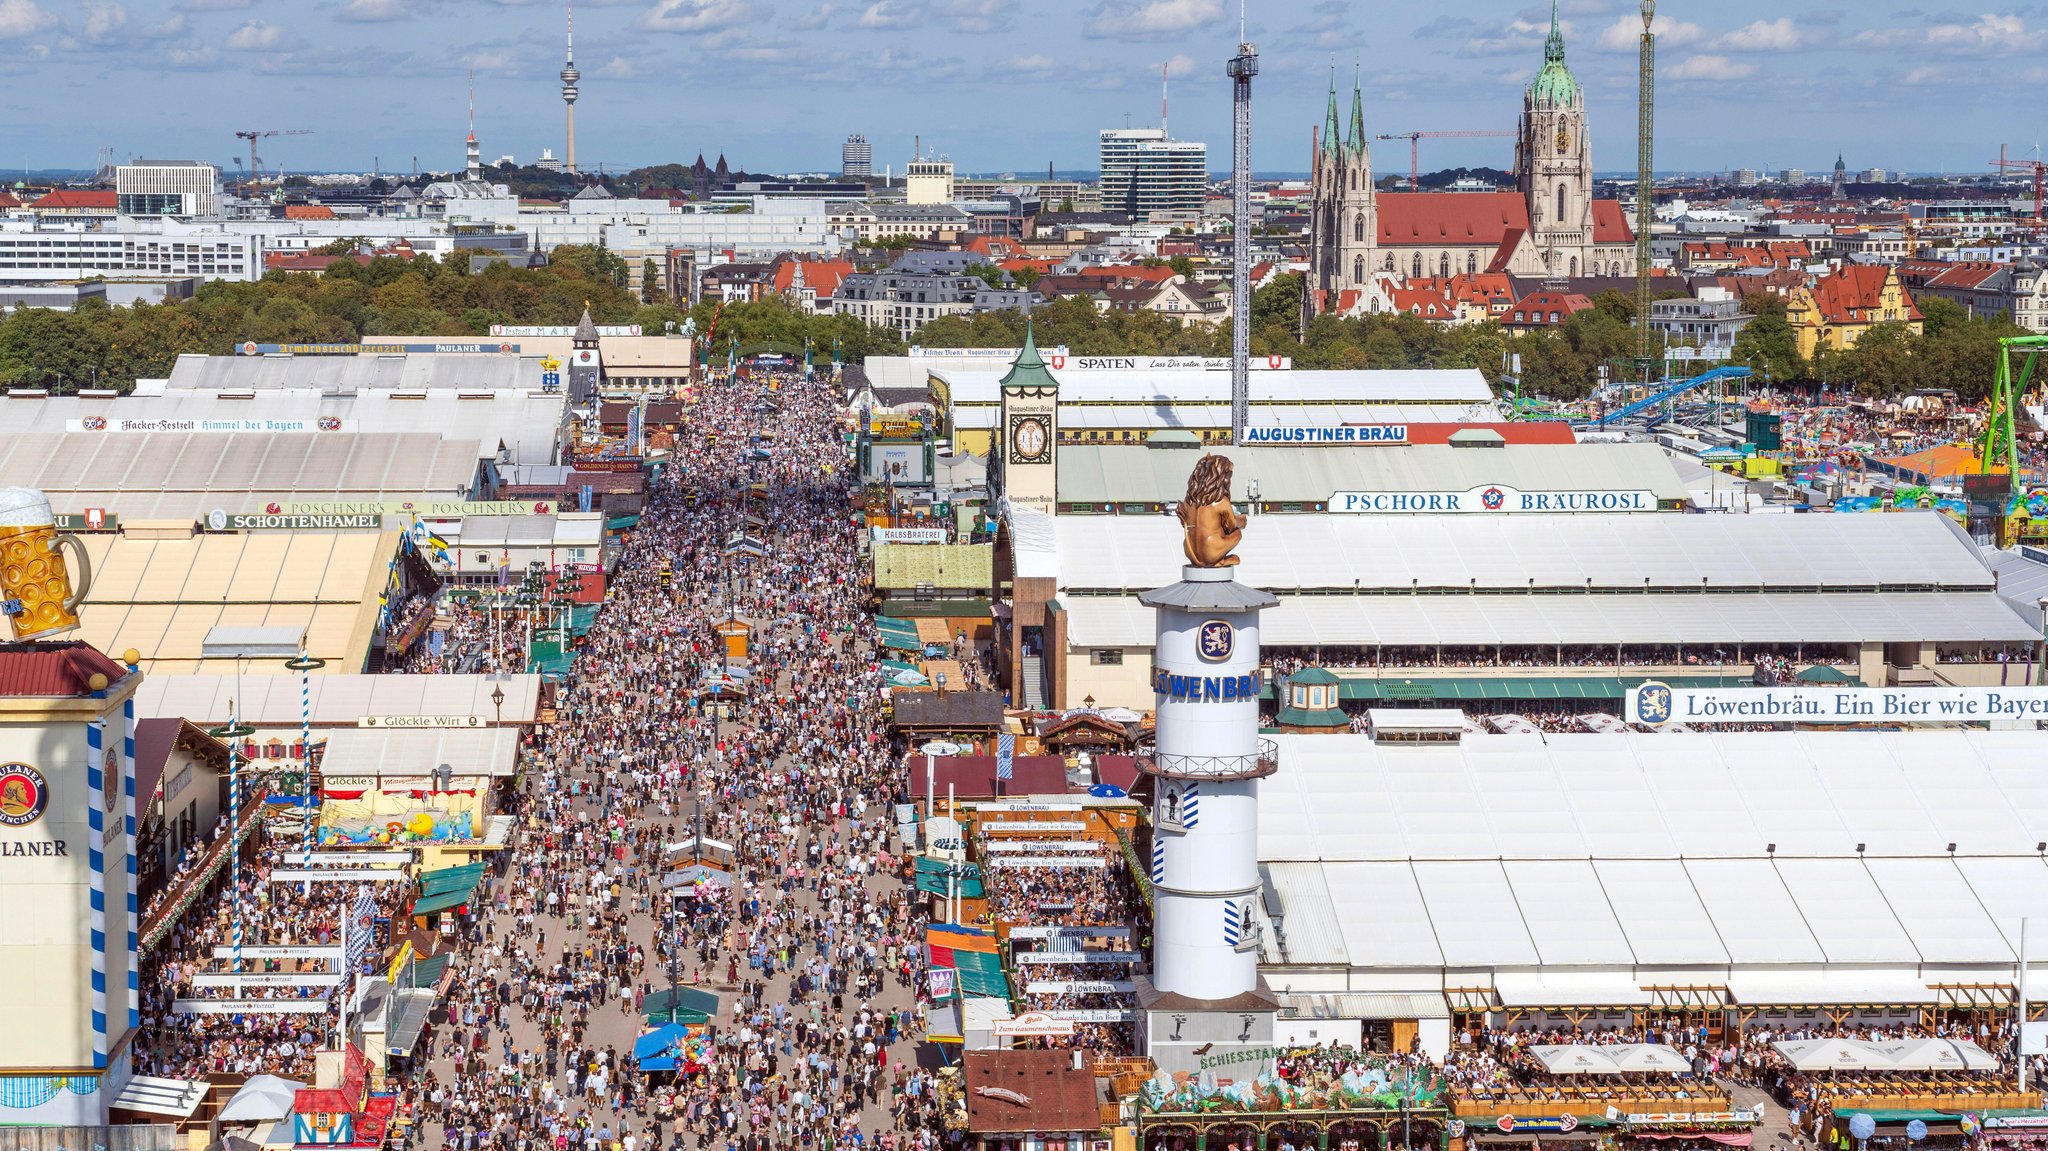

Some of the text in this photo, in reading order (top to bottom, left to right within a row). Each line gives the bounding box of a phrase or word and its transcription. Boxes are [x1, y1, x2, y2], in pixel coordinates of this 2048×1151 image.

[435, 344, 481, 352] PAULANER
[1078, 358, 1135, 369] SPATEN
[121, 420, 195, 432] Hacker-Festzelt
[245, 421, 261, 430] der
[266, 421, 304, 432] Bayern
[1248, 425, 1405, 441] AUGUSTINER BRÄU
[1345, 494, 1460, 510] PSCHORR
[1521, 493, 1646, 509] BRÄUROSL
[291, 502, 386, 514] POSCHNER'S
[432, 502, 526, 514] POSCHNER'S
[234, 515, 378, 528] SCHOTTENHAMEL
[1151, 665, 1264, 699] LÖWENBRÄ
[1686, 692, 2048, 719] Löwenbräu. Ein Bier wie Bayer
[384, 715, 460, 726] Glöckle Wirt
[0, 765, 43, 788] ULANER
[327, 776, 374, 785] Glöckle's
[2, 840, 69, 857] LANER
[1050, 1013, 1089, 1021] öwenbräu.
[1200, 1047, 1288, 1070] SCHIESSTAND
